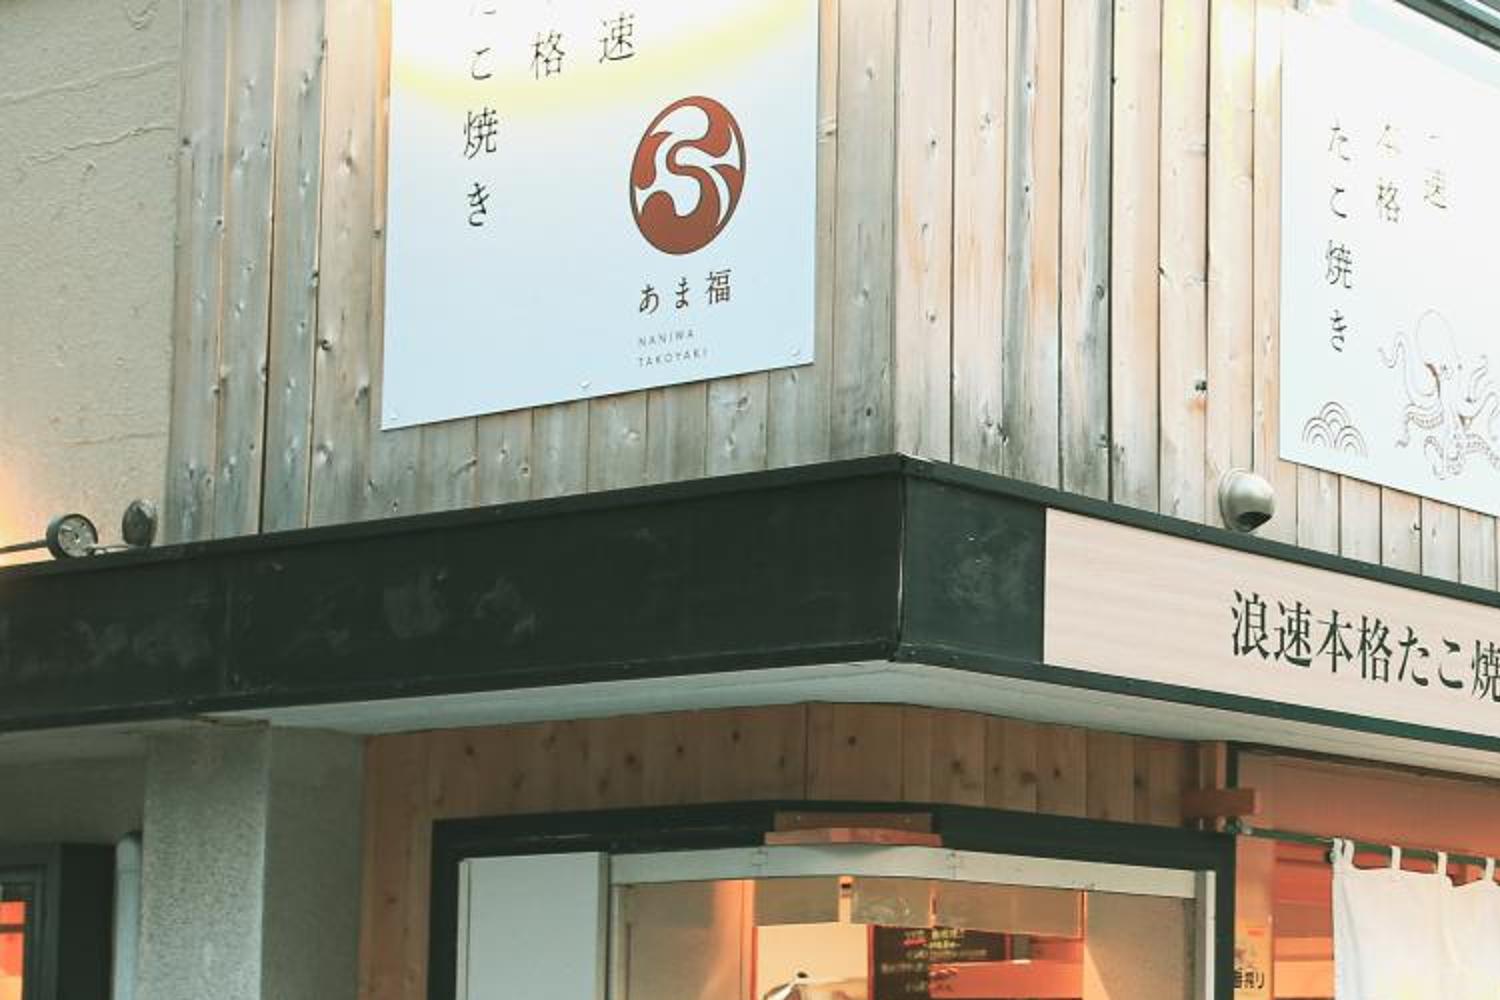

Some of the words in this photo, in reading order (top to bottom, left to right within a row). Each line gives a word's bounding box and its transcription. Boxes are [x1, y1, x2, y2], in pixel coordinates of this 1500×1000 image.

[463, 8, 499, 228] こ焼き
[639, 268, 733, 315] あま福
[638, 329, 695, 346] NANIWA
[638, 347, 708, 367] TAKOYAKI
